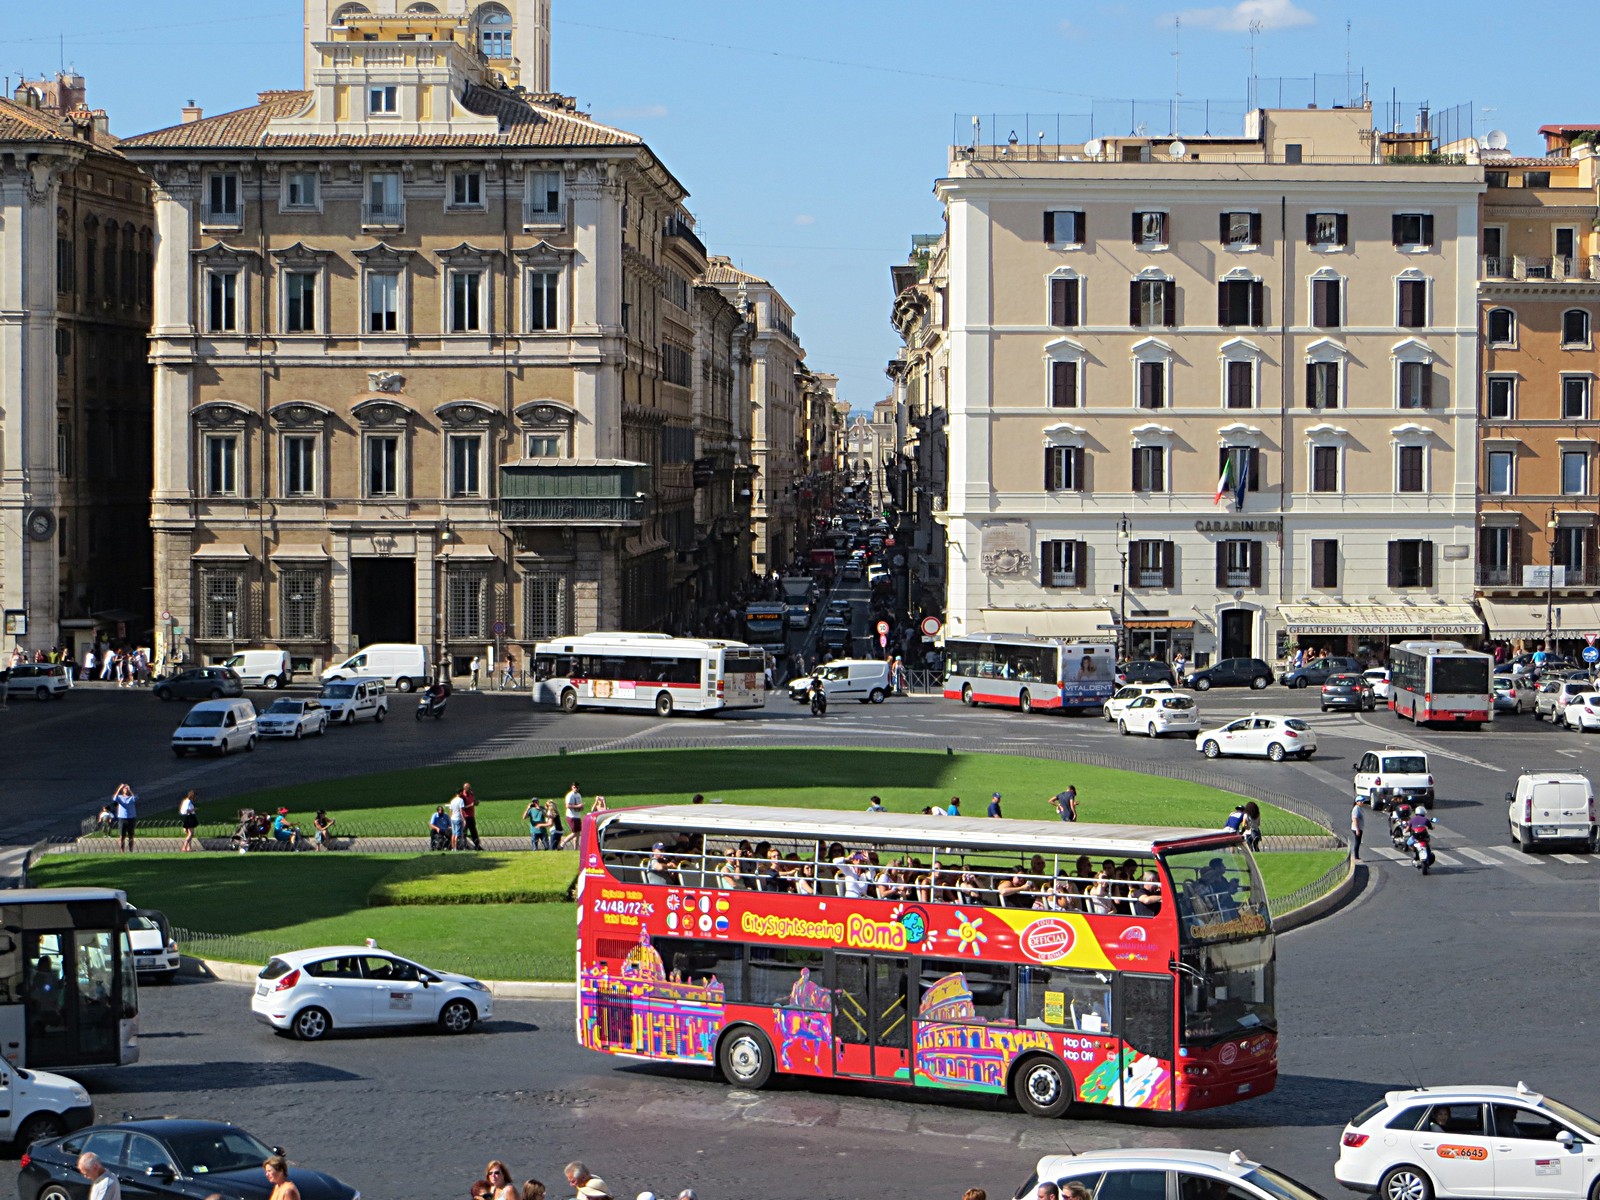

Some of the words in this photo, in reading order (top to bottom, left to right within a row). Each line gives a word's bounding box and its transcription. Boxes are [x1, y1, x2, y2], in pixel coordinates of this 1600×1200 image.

[1195, 520, 1281, 532] CARABINIERI
[1416, 625, 1480, 633] RISTORANTE
[594, 899, 641, 914] 24/48/72
[742, 911, 844, 942] CitySightseeing
[847, 913, 907, 950] Roma
[1030, 933, 1065, 946] OFFICIAL
[1063, 1037, 1079, 1048] Hop
[1081, 1038, 1092, 1048] On
[1063, 1050, 1079, 1060] Hop
[1081, 1051, 1094, 1061] Off
[1460, 1149, 1483, 1157] 6645
